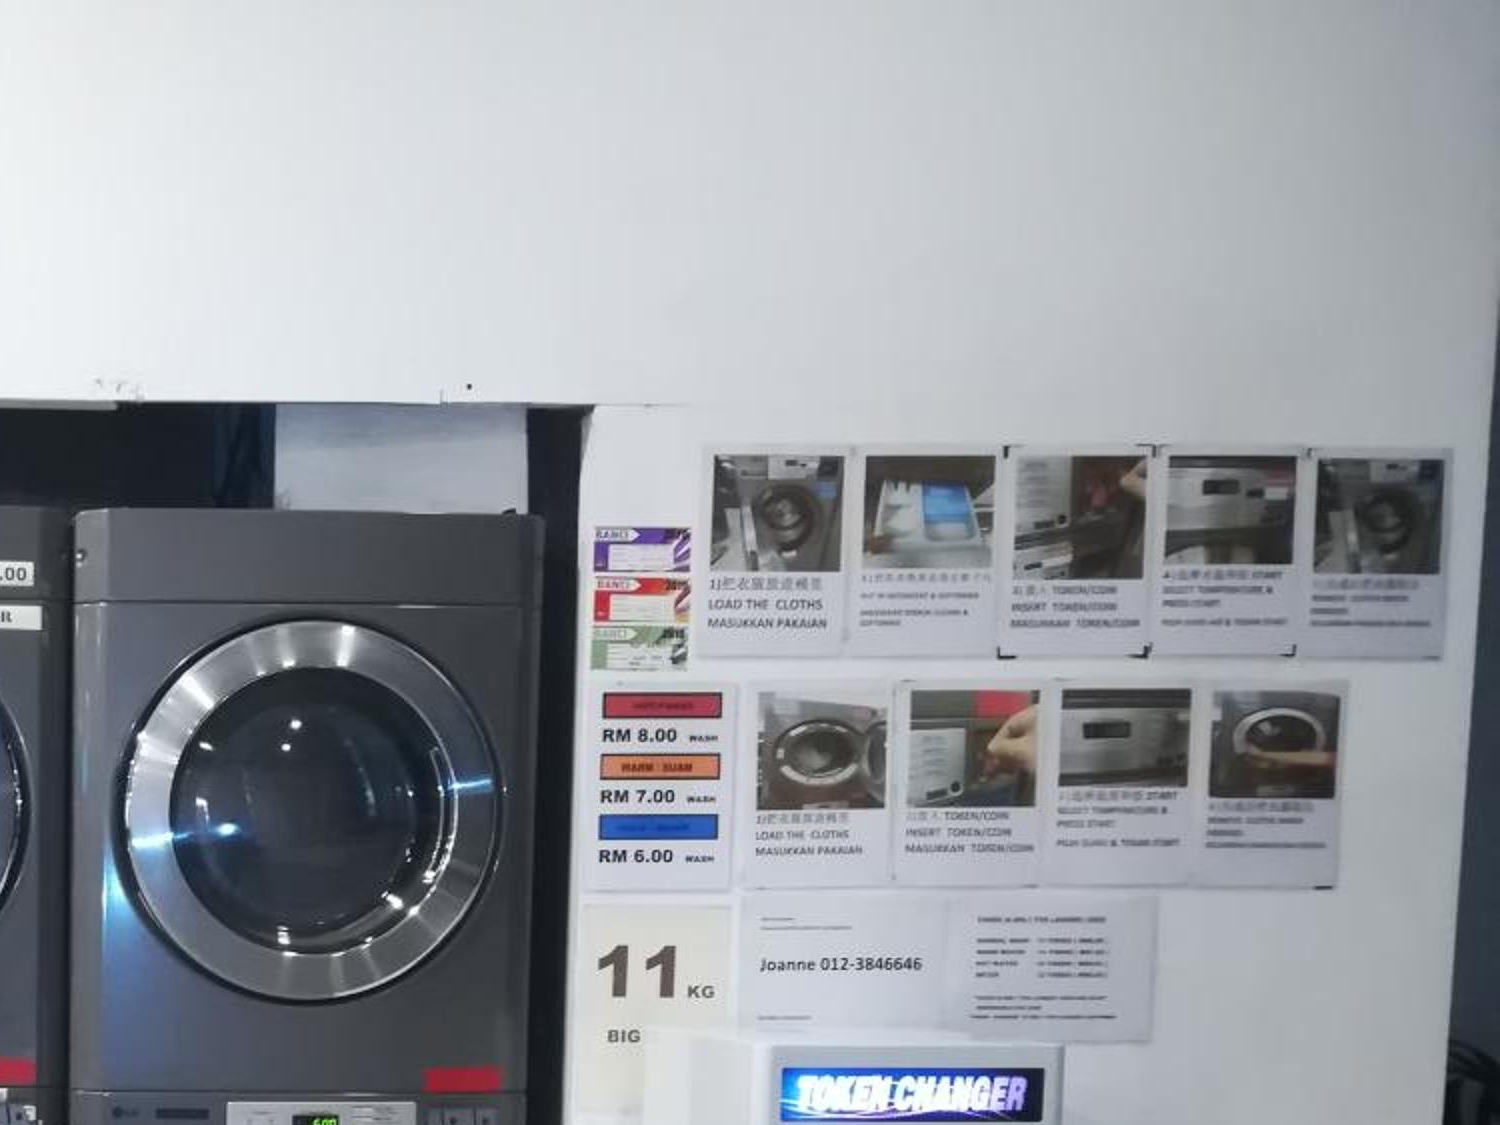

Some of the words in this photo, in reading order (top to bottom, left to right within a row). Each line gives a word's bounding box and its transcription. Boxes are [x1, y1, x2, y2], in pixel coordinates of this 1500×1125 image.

[708, 600, 742, 610] LOAD
[746, 600, 768, 610] THE
[776, 600, 822, 611] CLOTHS
[708, 619, 772, 628] MASUKKAN
[777, 619, 827, 628] PAKAIAN
[603, 730, 631, 742] RM
[638, 729, 677, 743] 8.00
[600, 790, 629, 803] RM
[636, 790, 675, 803] 7.00
[756, 832, 783, 840] LOAD
[599, 850, 627, 863] RM
[634, 850, 673, 863] 6.00
[598, 945, 677, 998] 11
[687, 986, 715, 998] KG
[760, 957, 815, 973] Joanne
[820, 957, 923, 972] 012-3846646
[607, 1030, 641, 1043] BIG
[798, 1075, 895, 1112] TOKEN
[896, 1075, 1028, 1112] CHANGER
